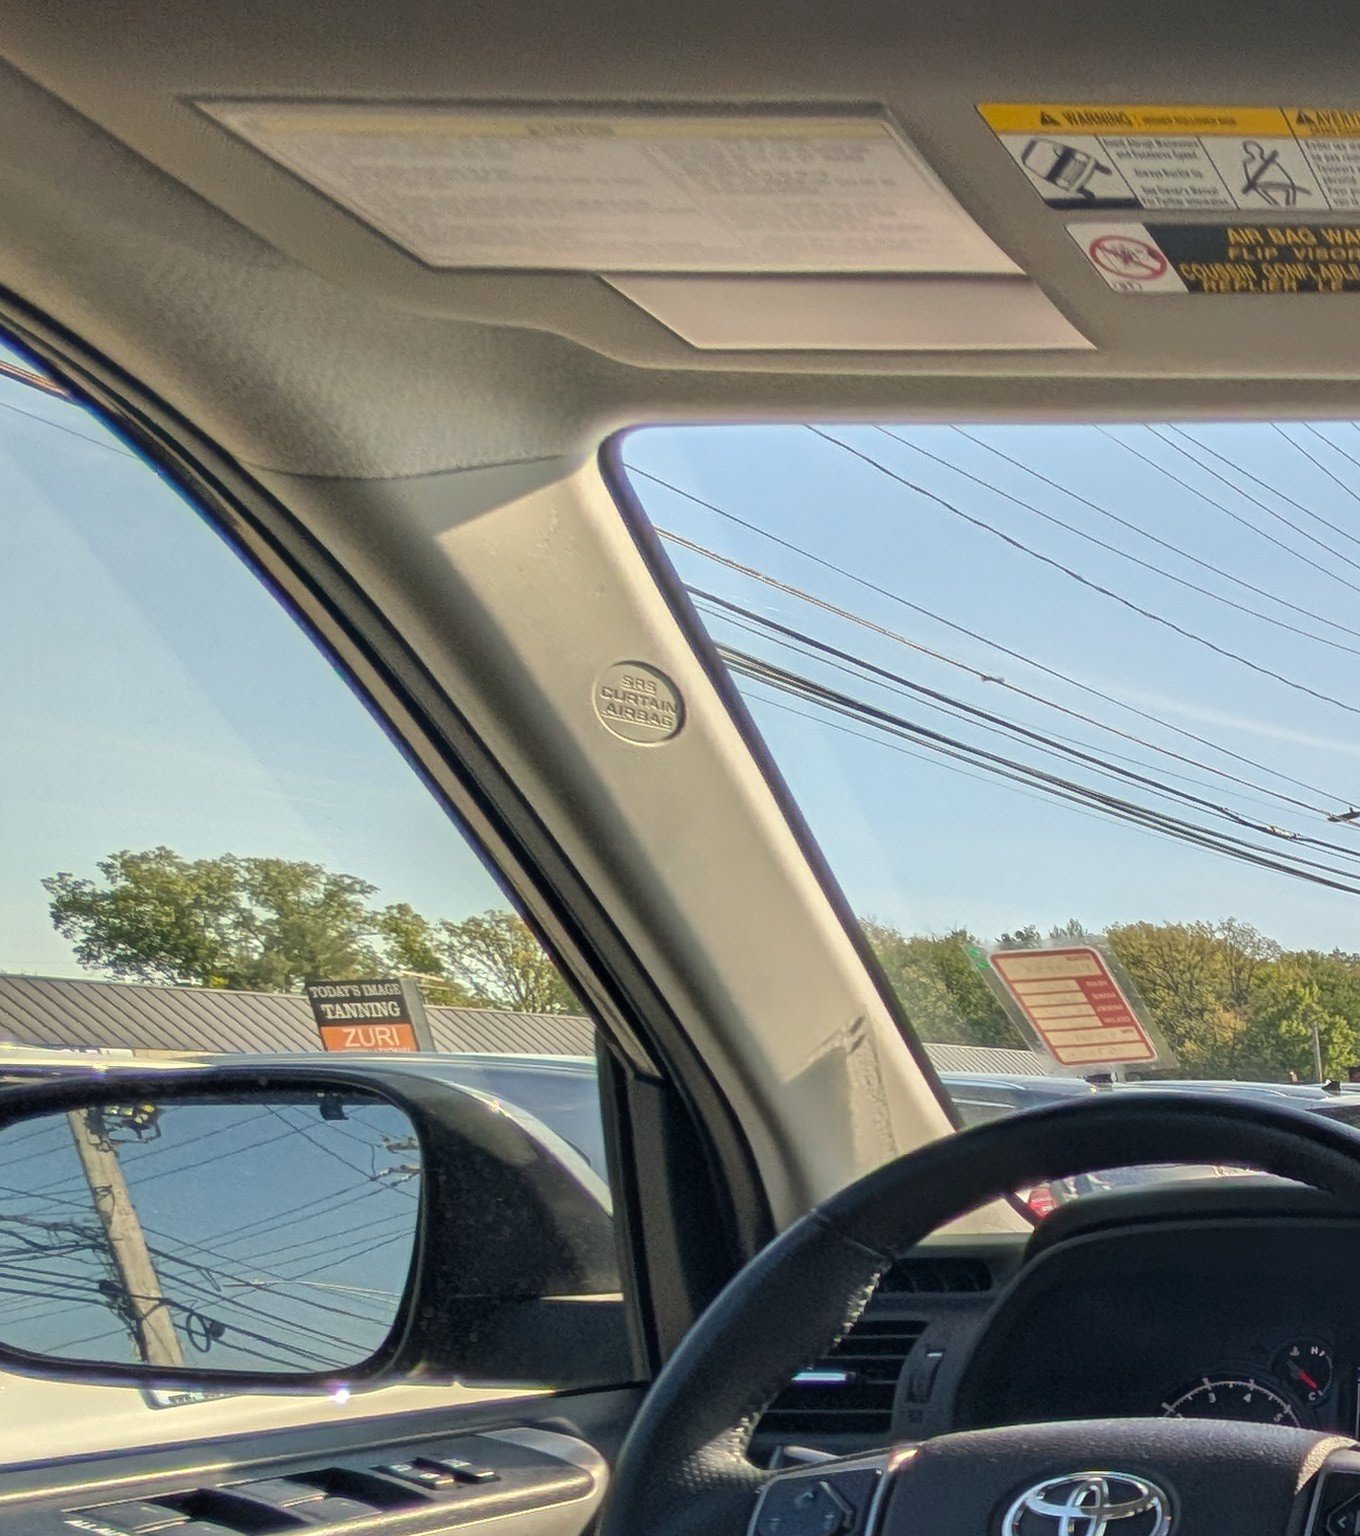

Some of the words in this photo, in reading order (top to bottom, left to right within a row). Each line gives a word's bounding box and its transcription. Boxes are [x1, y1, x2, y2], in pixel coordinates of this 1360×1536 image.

[1061, 110, 1133, 127] WARNING
[1226, 227, 1264, 246] AIR
[1268, 228, 1318, 246] BAG
[1226, 246, 1278, 262] FLIP
[621, 674, 658, 696] SRS
[599, 685, 677, 716] CURTAIN
[602, 702, 674, 731] AIRBAG
[308, 984, 362, 999] TODAY'S
[360, 983, 402, 997] IMAGE
[320, 1000, 402, 1020] TANNING
[341, 1027, 401, 1048] ZURI
[1207, 1392, 1217, 1404] 3
[1243, 1393, 1252, 1403] 4
